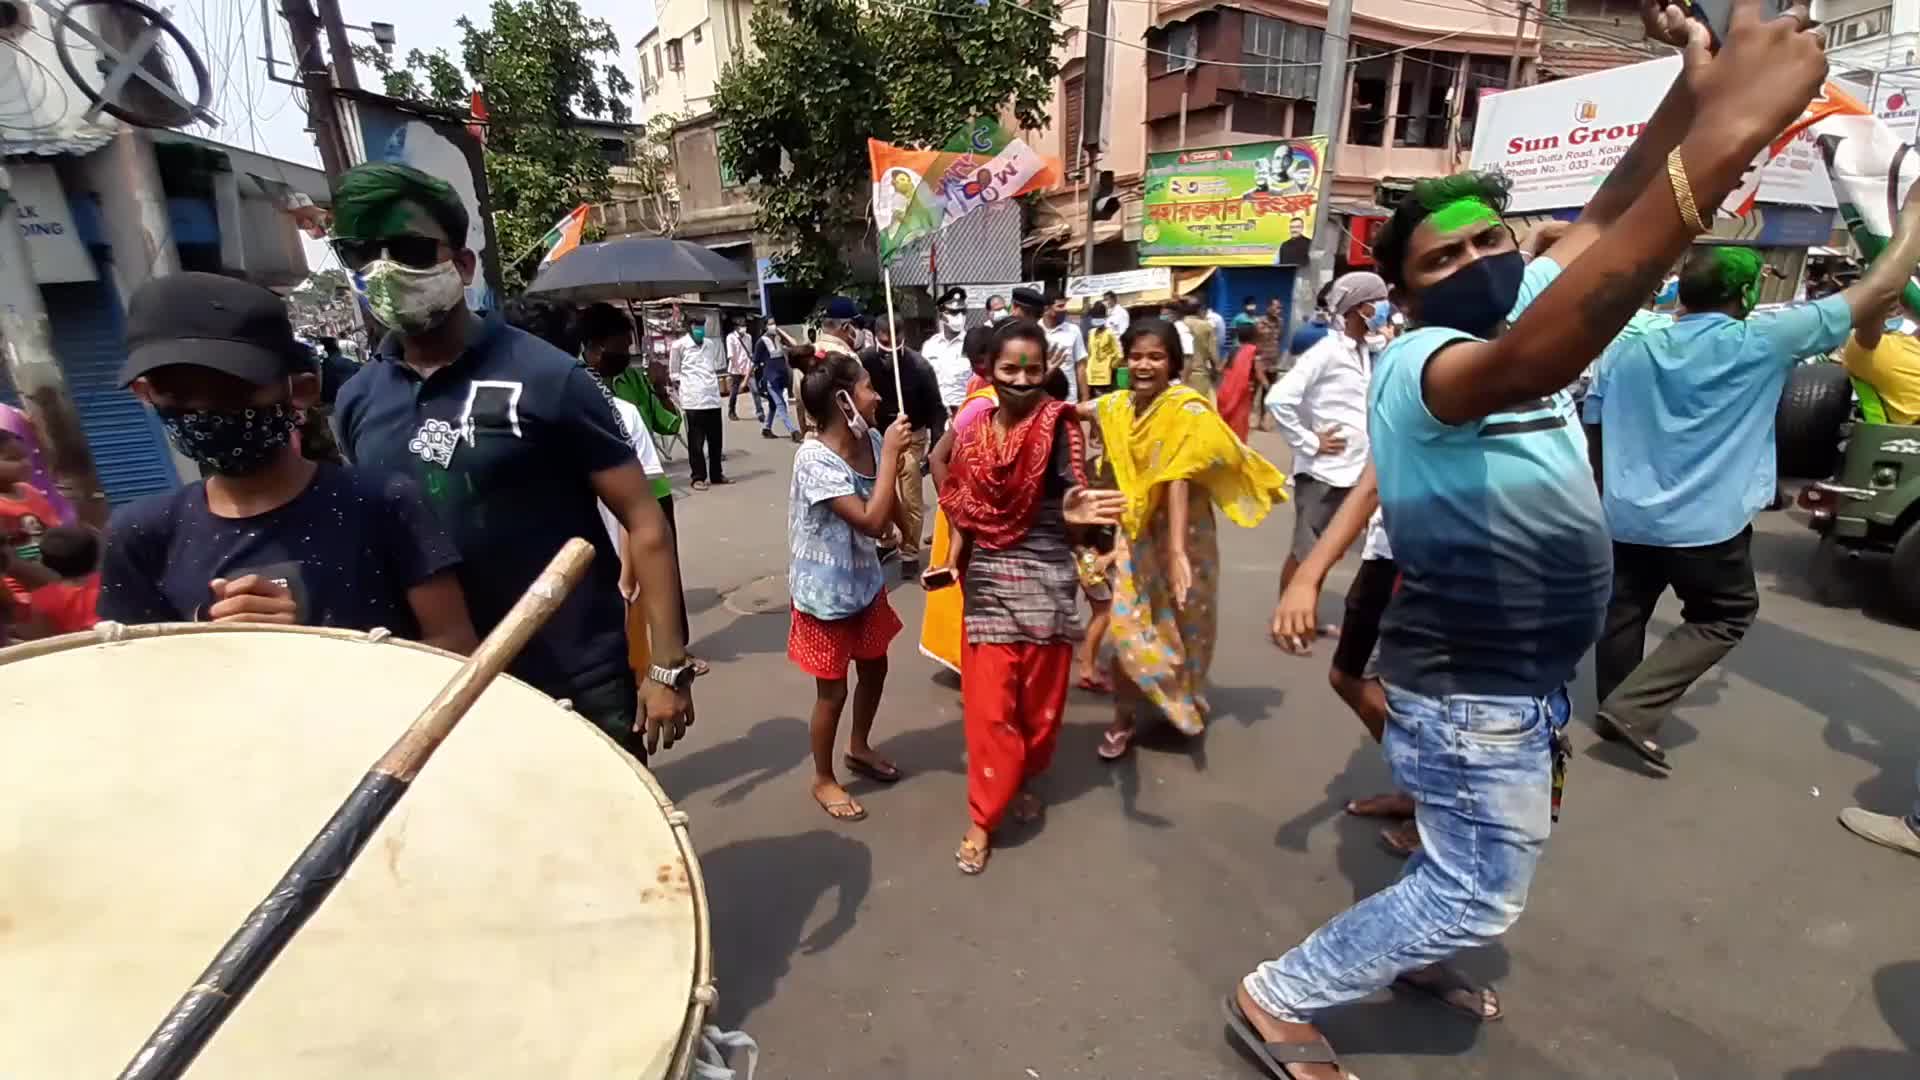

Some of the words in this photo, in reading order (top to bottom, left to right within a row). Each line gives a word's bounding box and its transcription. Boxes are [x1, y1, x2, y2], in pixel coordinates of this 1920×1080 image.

[1507, 136, 1559, 155] Sun
[1568, 122, 1648, 145] Grou
[1598, 144, 1631, 156] Kolka
[1505, 167, 1538, 177] Phone
[1568, 159, 1589, 171] 033
